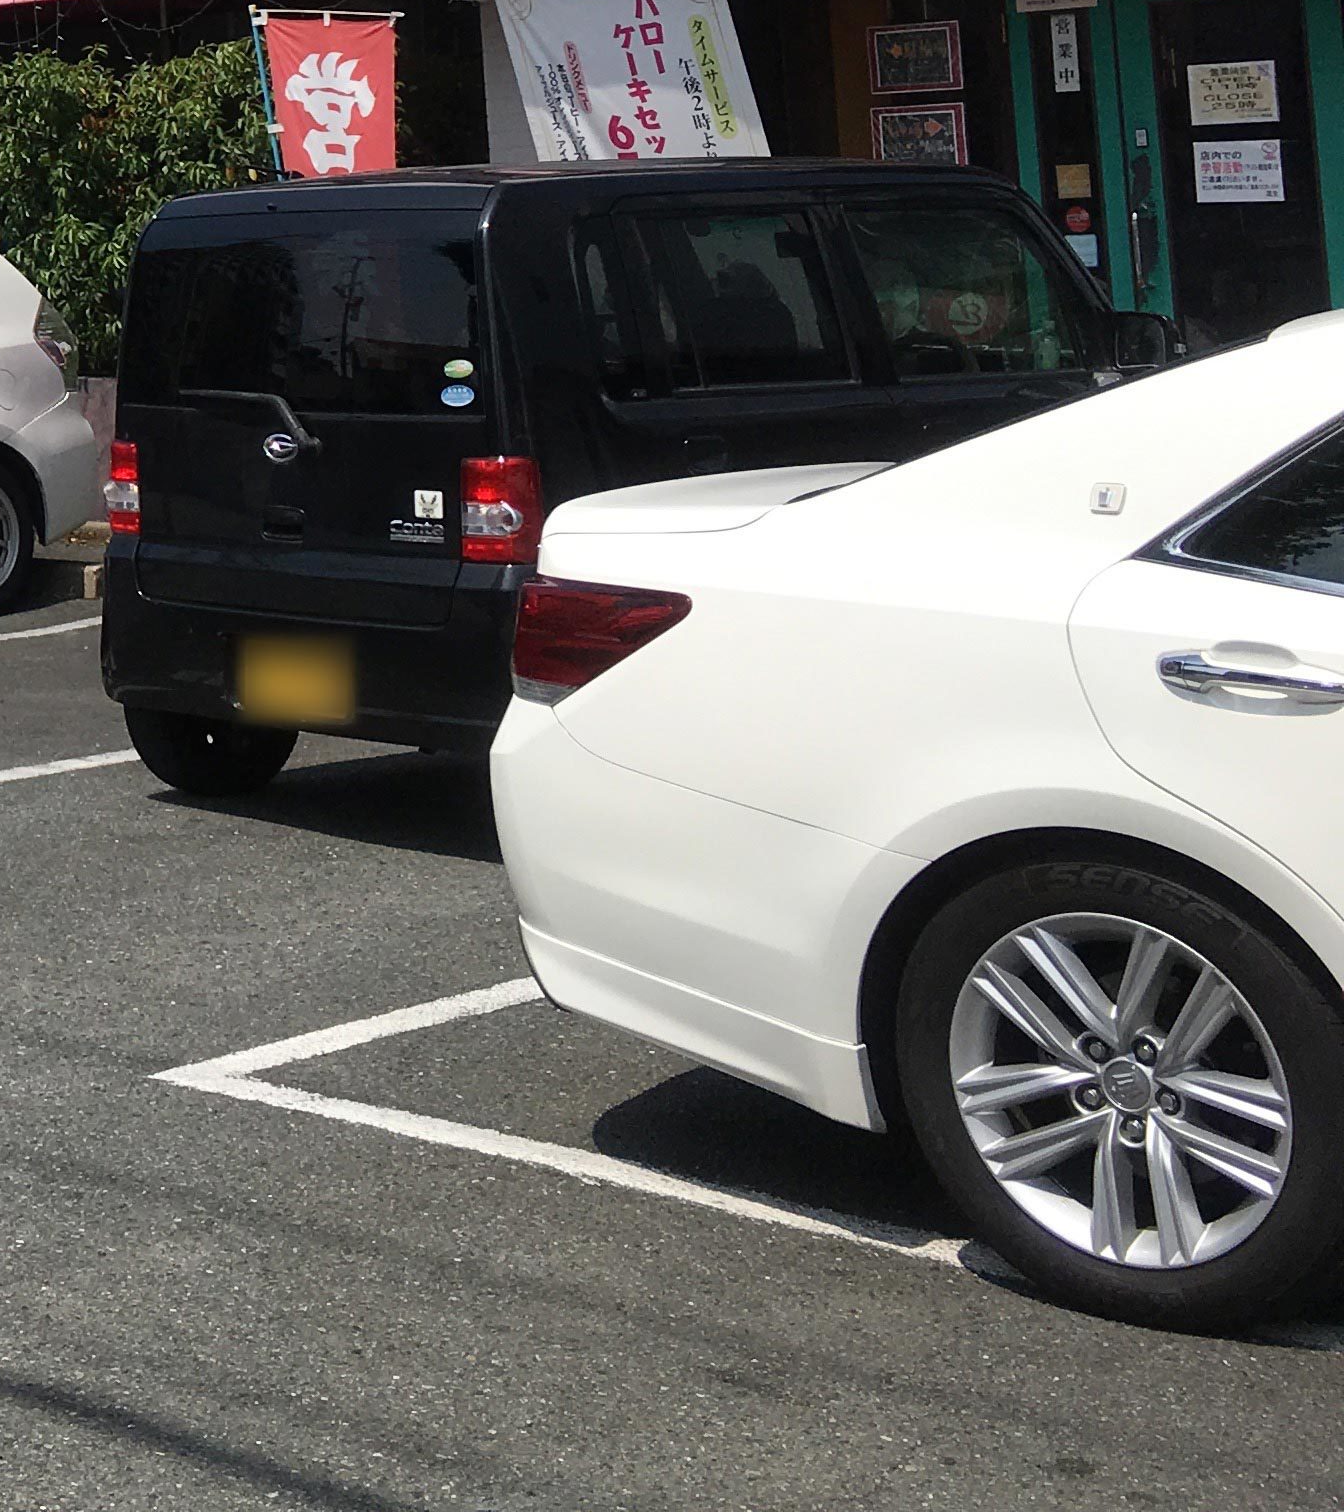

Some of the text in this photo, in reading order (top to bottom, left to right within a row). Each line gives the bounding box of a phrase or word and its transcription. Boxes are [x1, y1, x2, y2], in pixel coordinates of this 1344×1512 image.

[691, 19, 735, 133] タイムサービス
[1055, 17, 1074, 84] 営業中
[608, 115, 639, 160] 6
